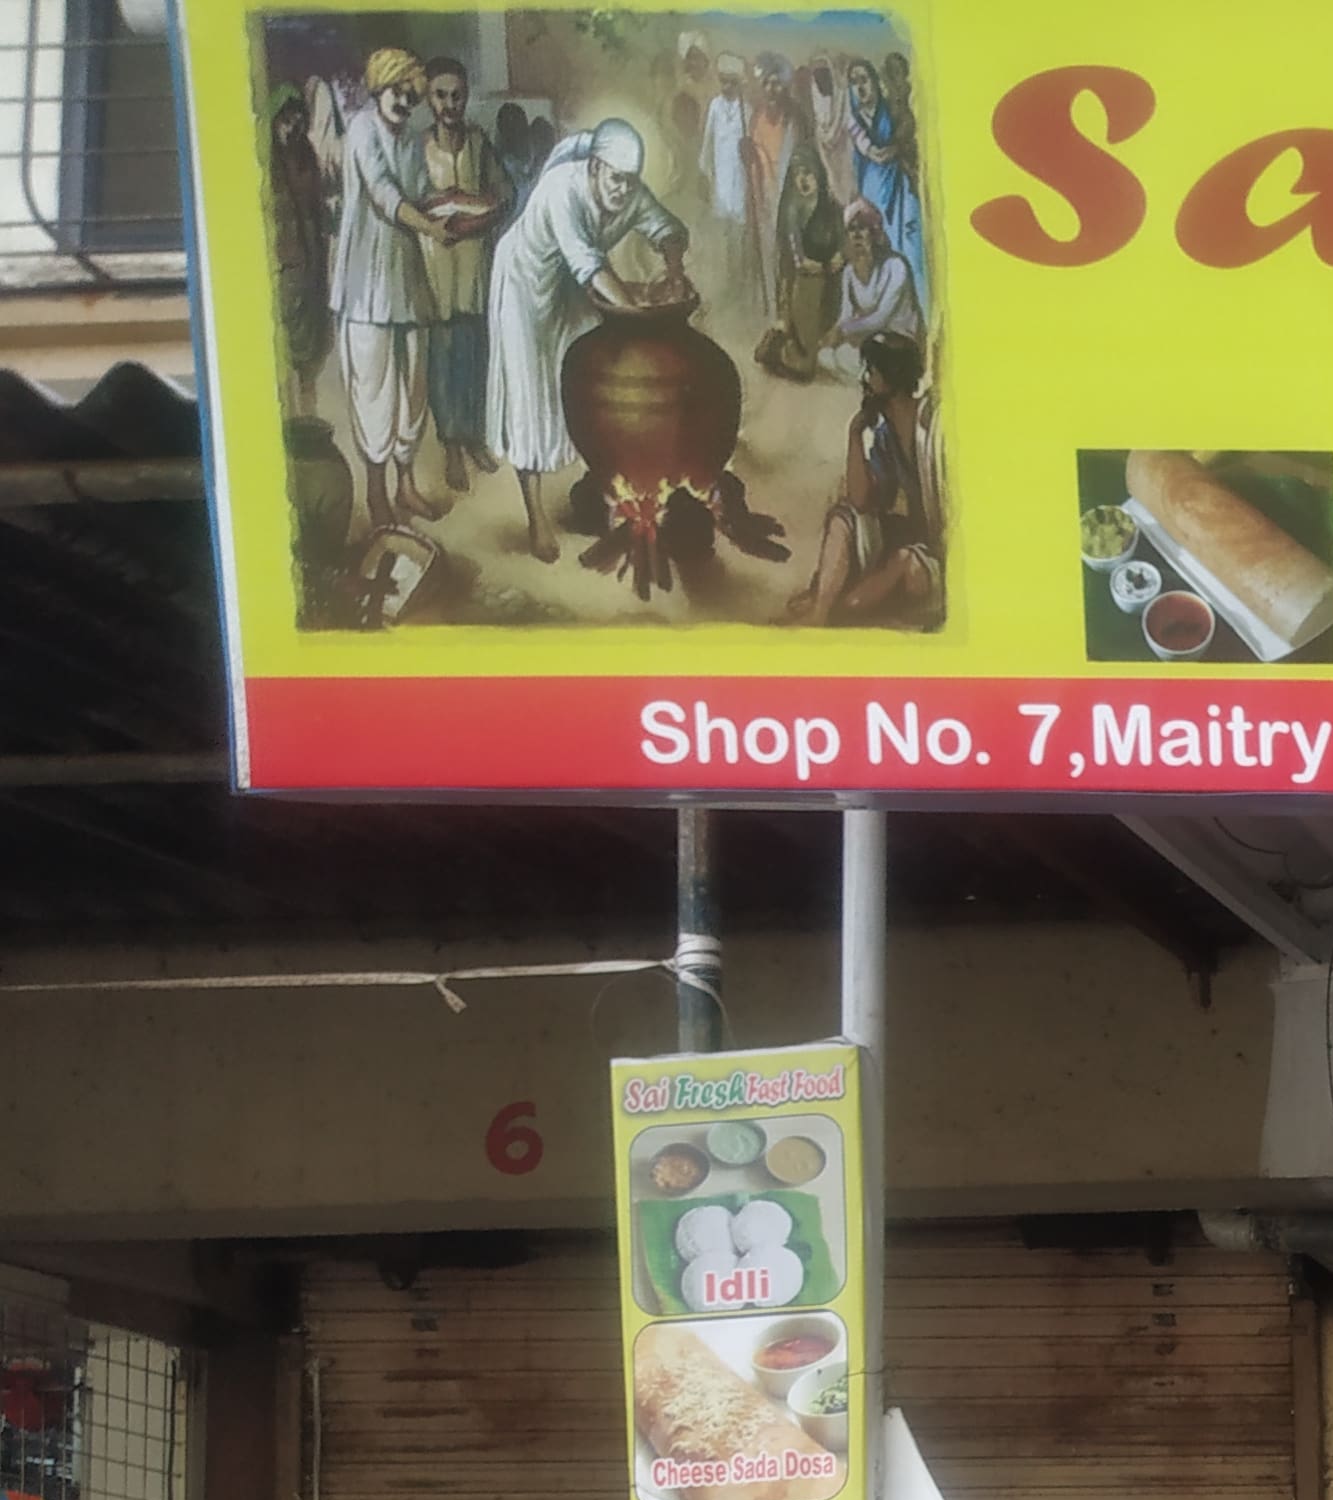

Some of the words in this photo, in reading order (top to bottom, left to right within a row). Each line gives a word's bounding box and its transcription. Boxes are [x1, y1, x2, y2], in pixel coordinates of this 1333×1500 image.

[640, 700, 842, 781] Shop
[866, 702, 990, 766] No.
[625, 1077, 669, 1113] Sai
[674, 1072, 746, 1109] Fresh
[746, 1072, 790, 1106] Fast
[792, 1065, 844, 1100] Food
[486, 1101, 543, 1175] 6
[704, 1269, 771, 1304] Idli
[653, 1459, 728, 1488] Cheese
[733, 1453, 778, 1481] Sada
[784, 1450, 835, 1478] Dosa
